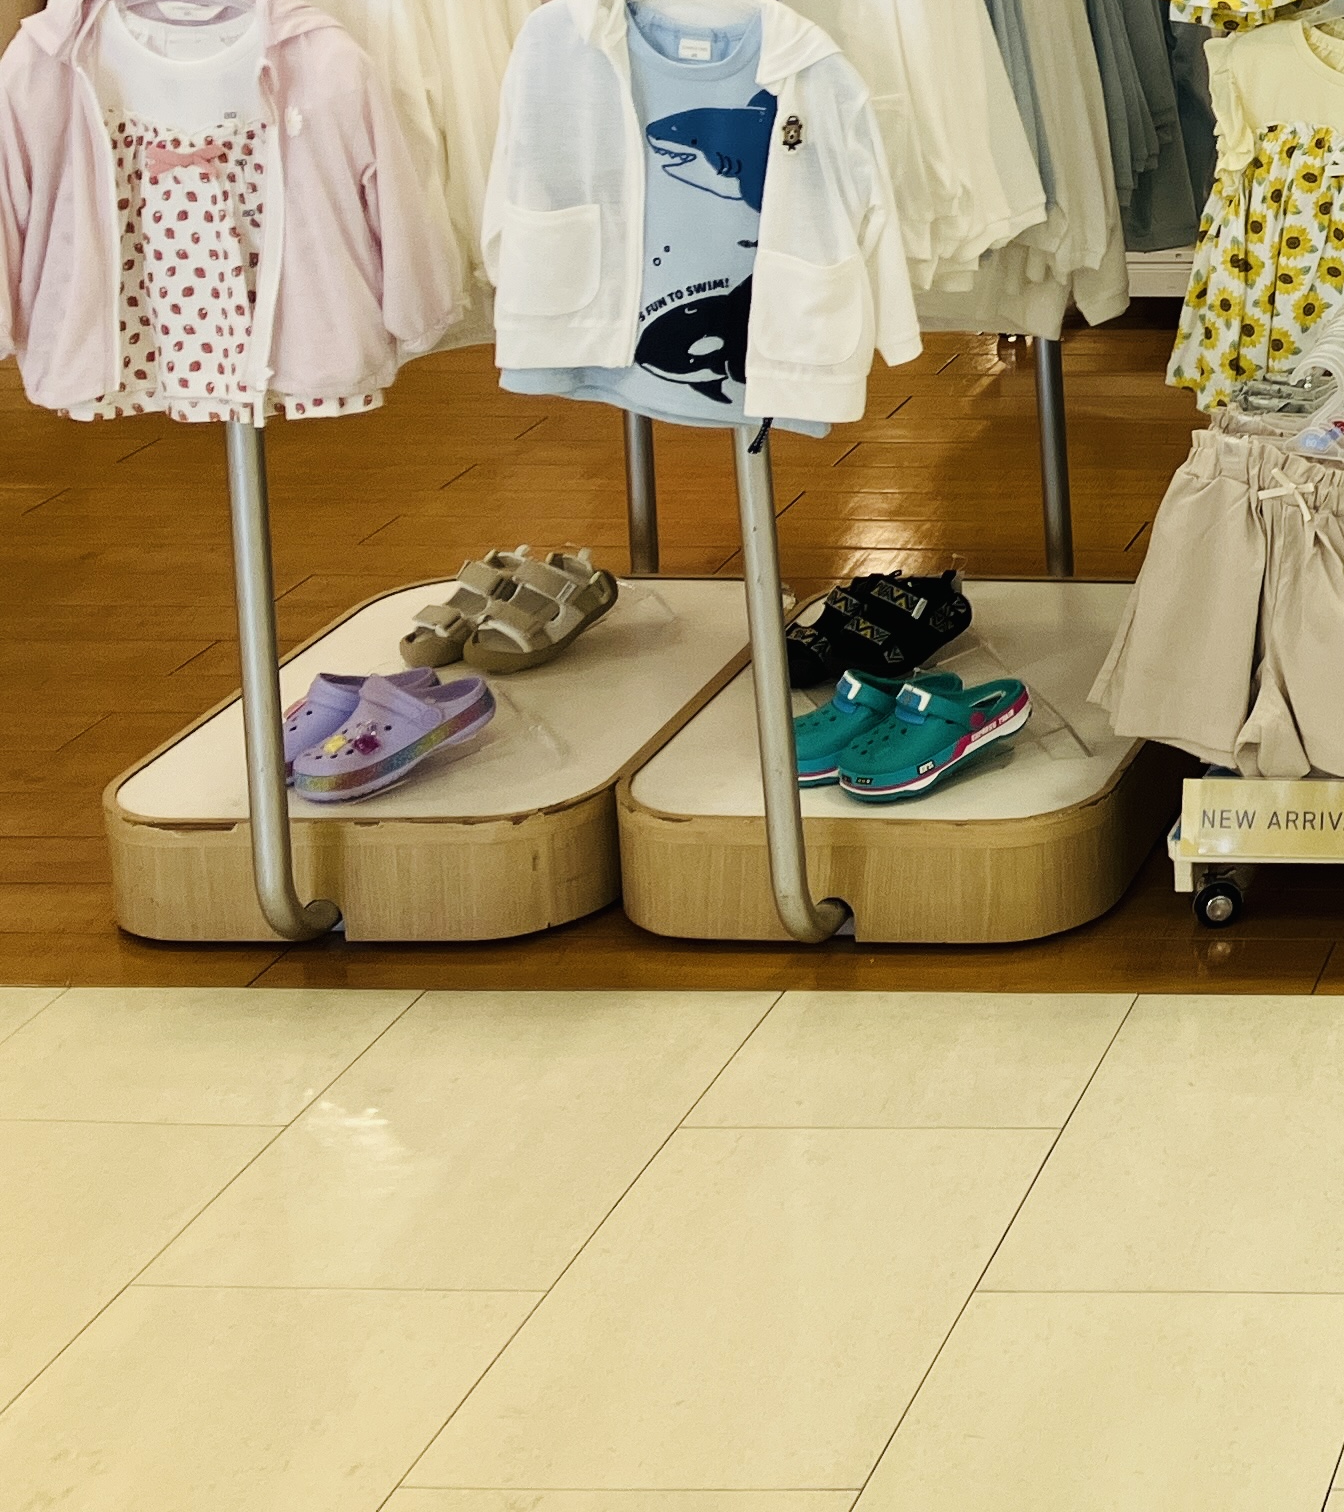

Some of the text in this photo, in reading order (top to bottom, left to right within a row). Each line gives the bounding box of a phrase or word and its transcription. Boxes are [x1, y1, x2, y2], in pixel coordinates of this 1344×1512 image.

[646, 277, 730, 316] FUN TO SWIM!
[1202, 809, 1256, 829] NEW
